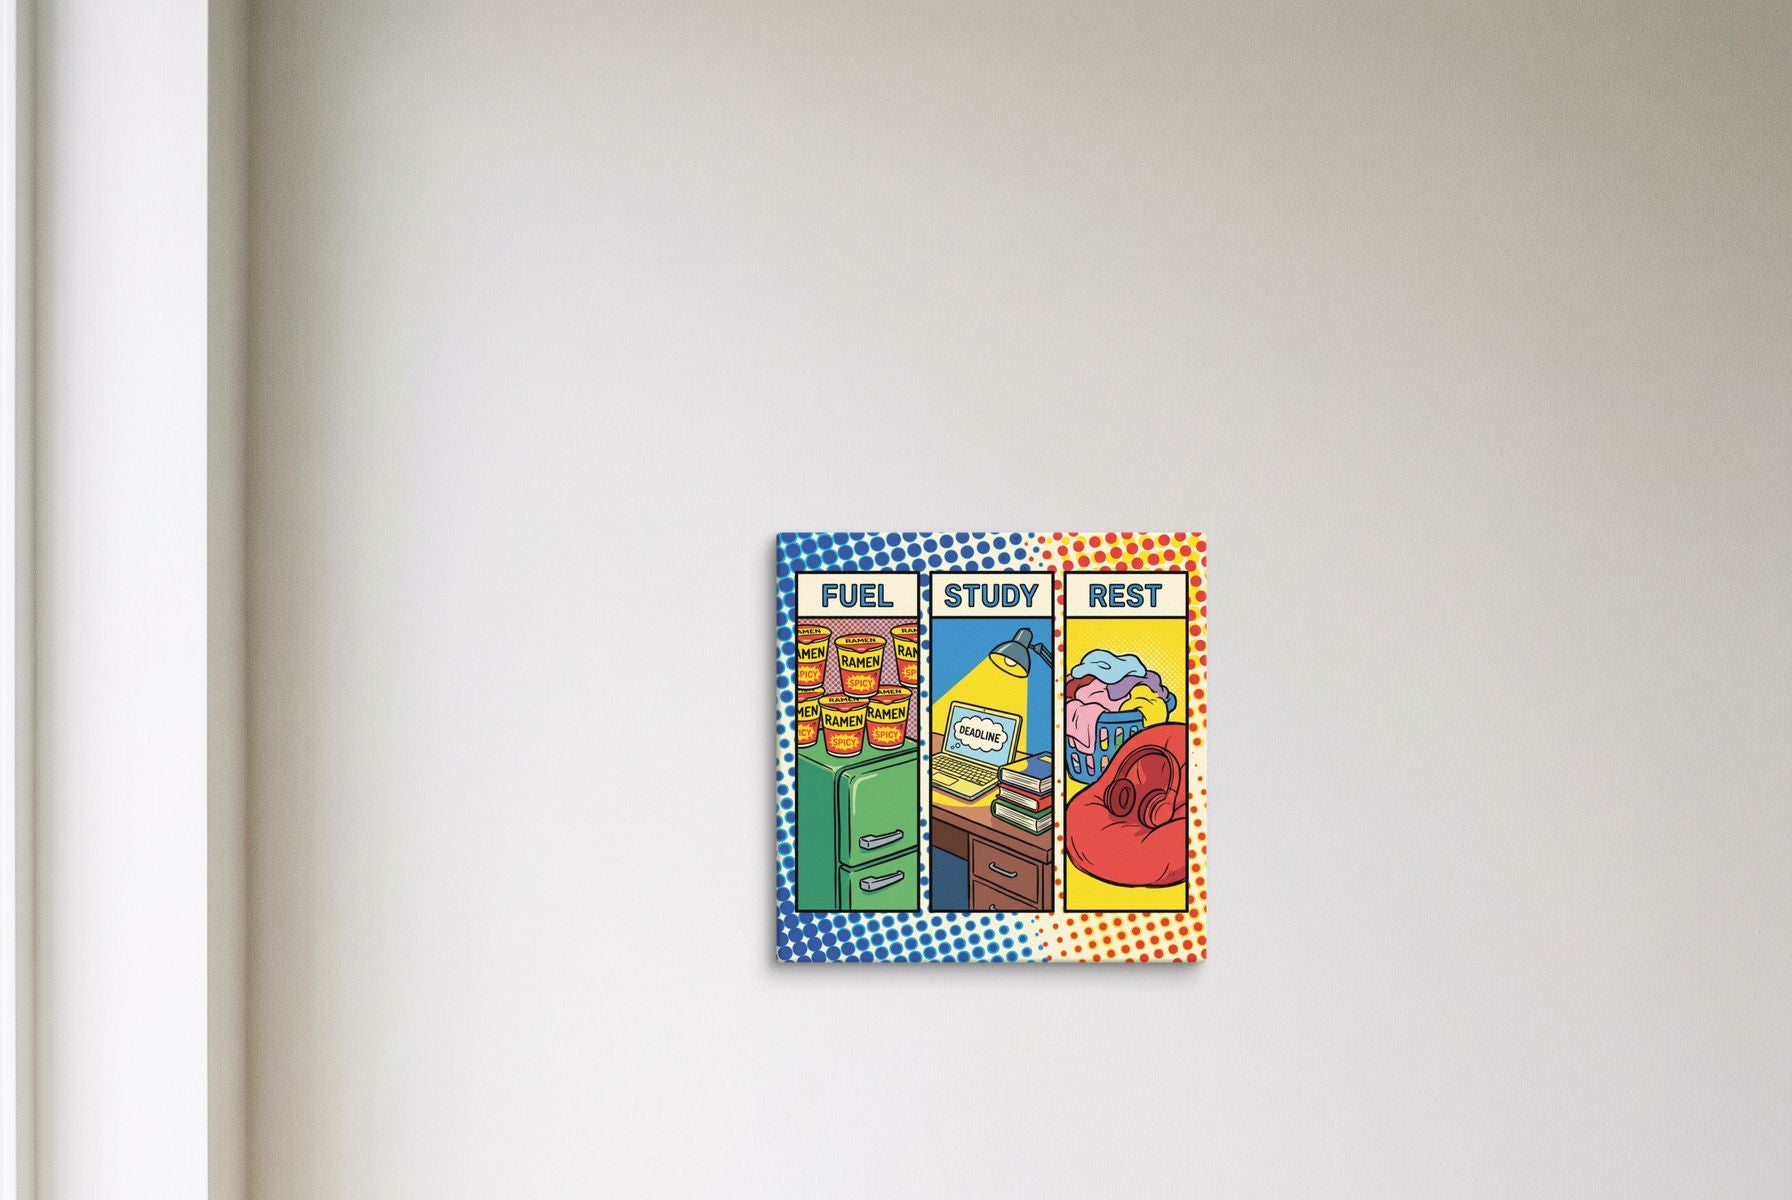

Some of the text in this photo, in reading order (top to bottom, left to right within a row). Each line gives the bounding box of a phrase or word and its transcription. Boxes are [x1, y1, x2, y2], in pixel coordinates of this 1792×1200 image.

[821, 583, 894, 608] FUEL
[944, 583, 1039, 608] STUDY
[1089, 583, 1162, 608] REST
[798, 646, 825, 660] AMEN
[841, 655, 880, 668] RAMEN
[798, 670, 818, 678] PICY
[849, 679, 873, 687] SPICY
[798, 704, 819, 718] MEN
[867, 707, 906, 720] RAMEN
[825, 714, 863, 727] RAMEN
[798, 728, 811, 737] ICY
[875, 731, 898, 739] SPICY
[959, 725, 1001, 744] DEADLINE
[832, 738, 856, 746] SPICY
